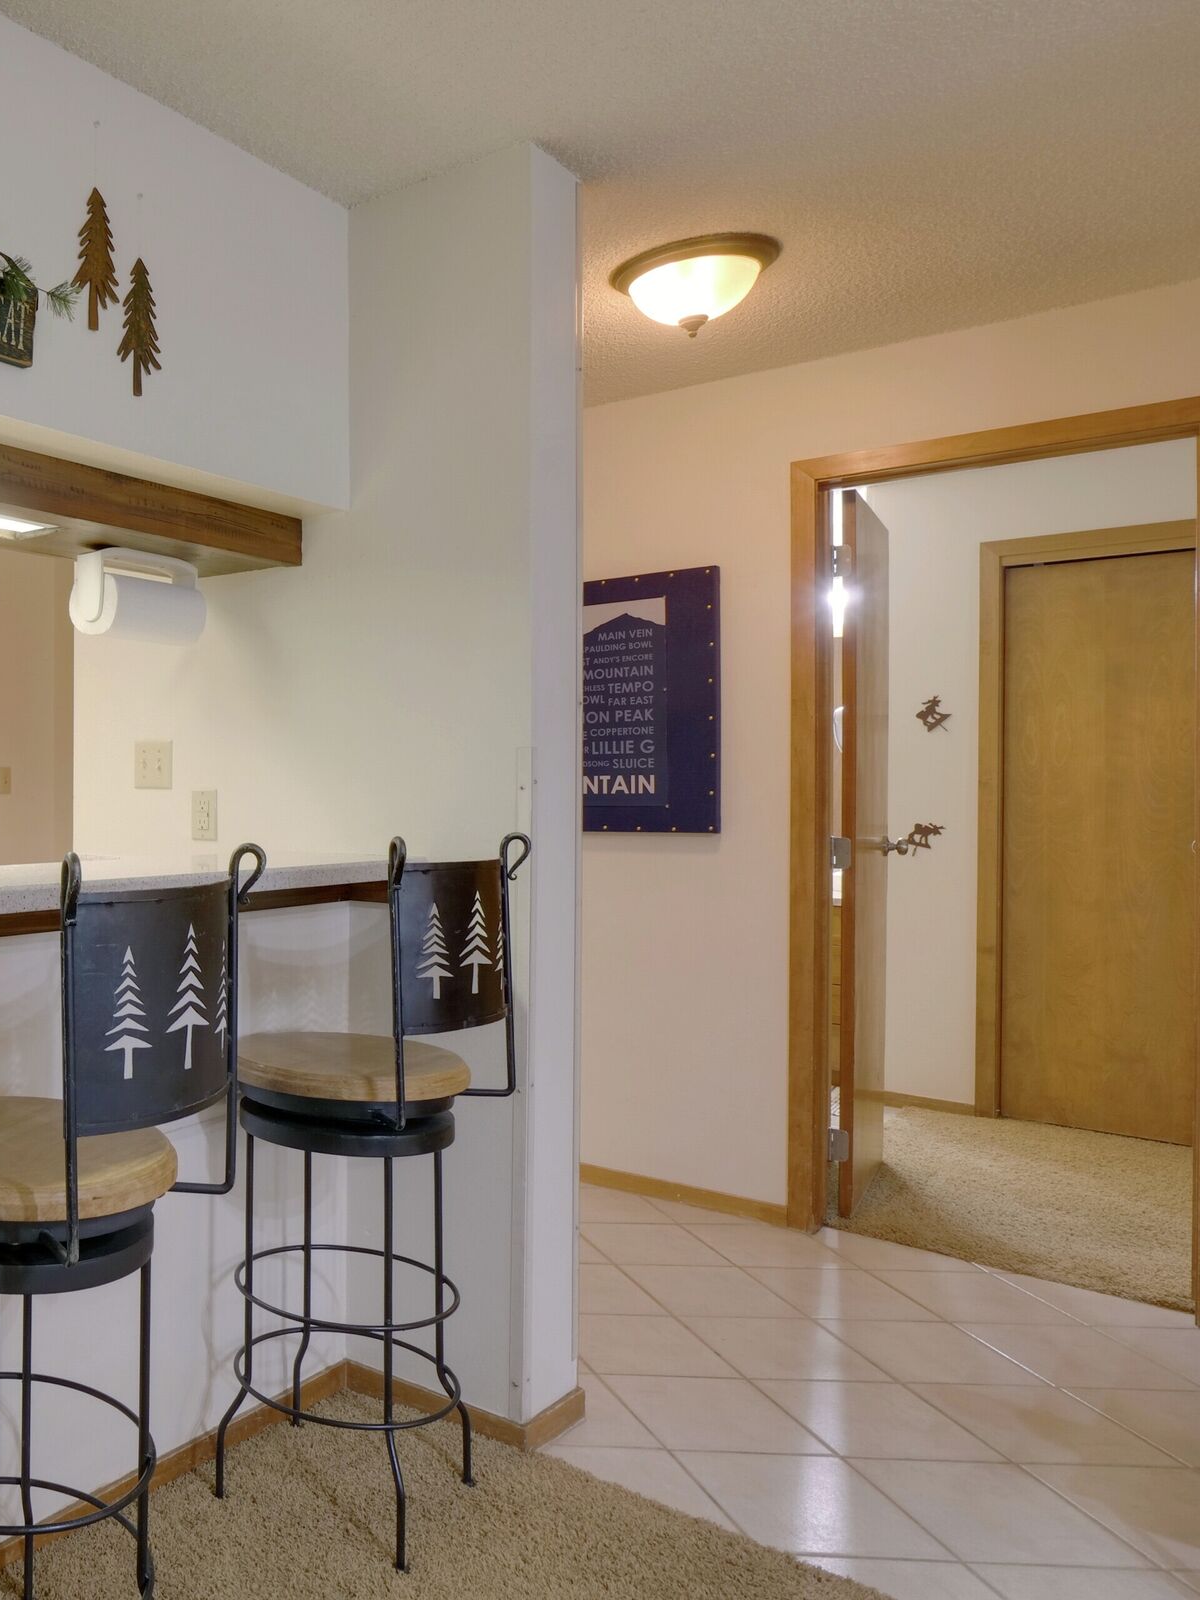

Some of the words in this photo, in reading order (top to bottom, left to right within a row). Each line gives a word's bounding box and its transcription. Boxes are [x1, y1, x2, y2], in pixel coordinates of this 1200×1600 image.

[598, 630, 626, 641] MAIN
[629, 628, 653, 639] VEIN
[583, 643, 627, 653] PAULDING
[628, 641, 653, 650] BOWL
[593, 656, 620, 665] ANDY'S
[622, 653, 653, 662] ENCORE
[583, 665, 654, 680] MOUNTAIN
[608, 680, 654, 694] TEMPO
[608, 698, 627, 706] FAR
[630, 695, 654, 705] EAST
[615, 708, 654, 722] PEAK
[590, 726, 654, 737] COPPERTONE
[591, 740, 634, 755] LILLIE
[640, 739, 655, 754] G
[613, 758, 655, 769] SLUICE
[583, 774, 655, 795] NTAIN
